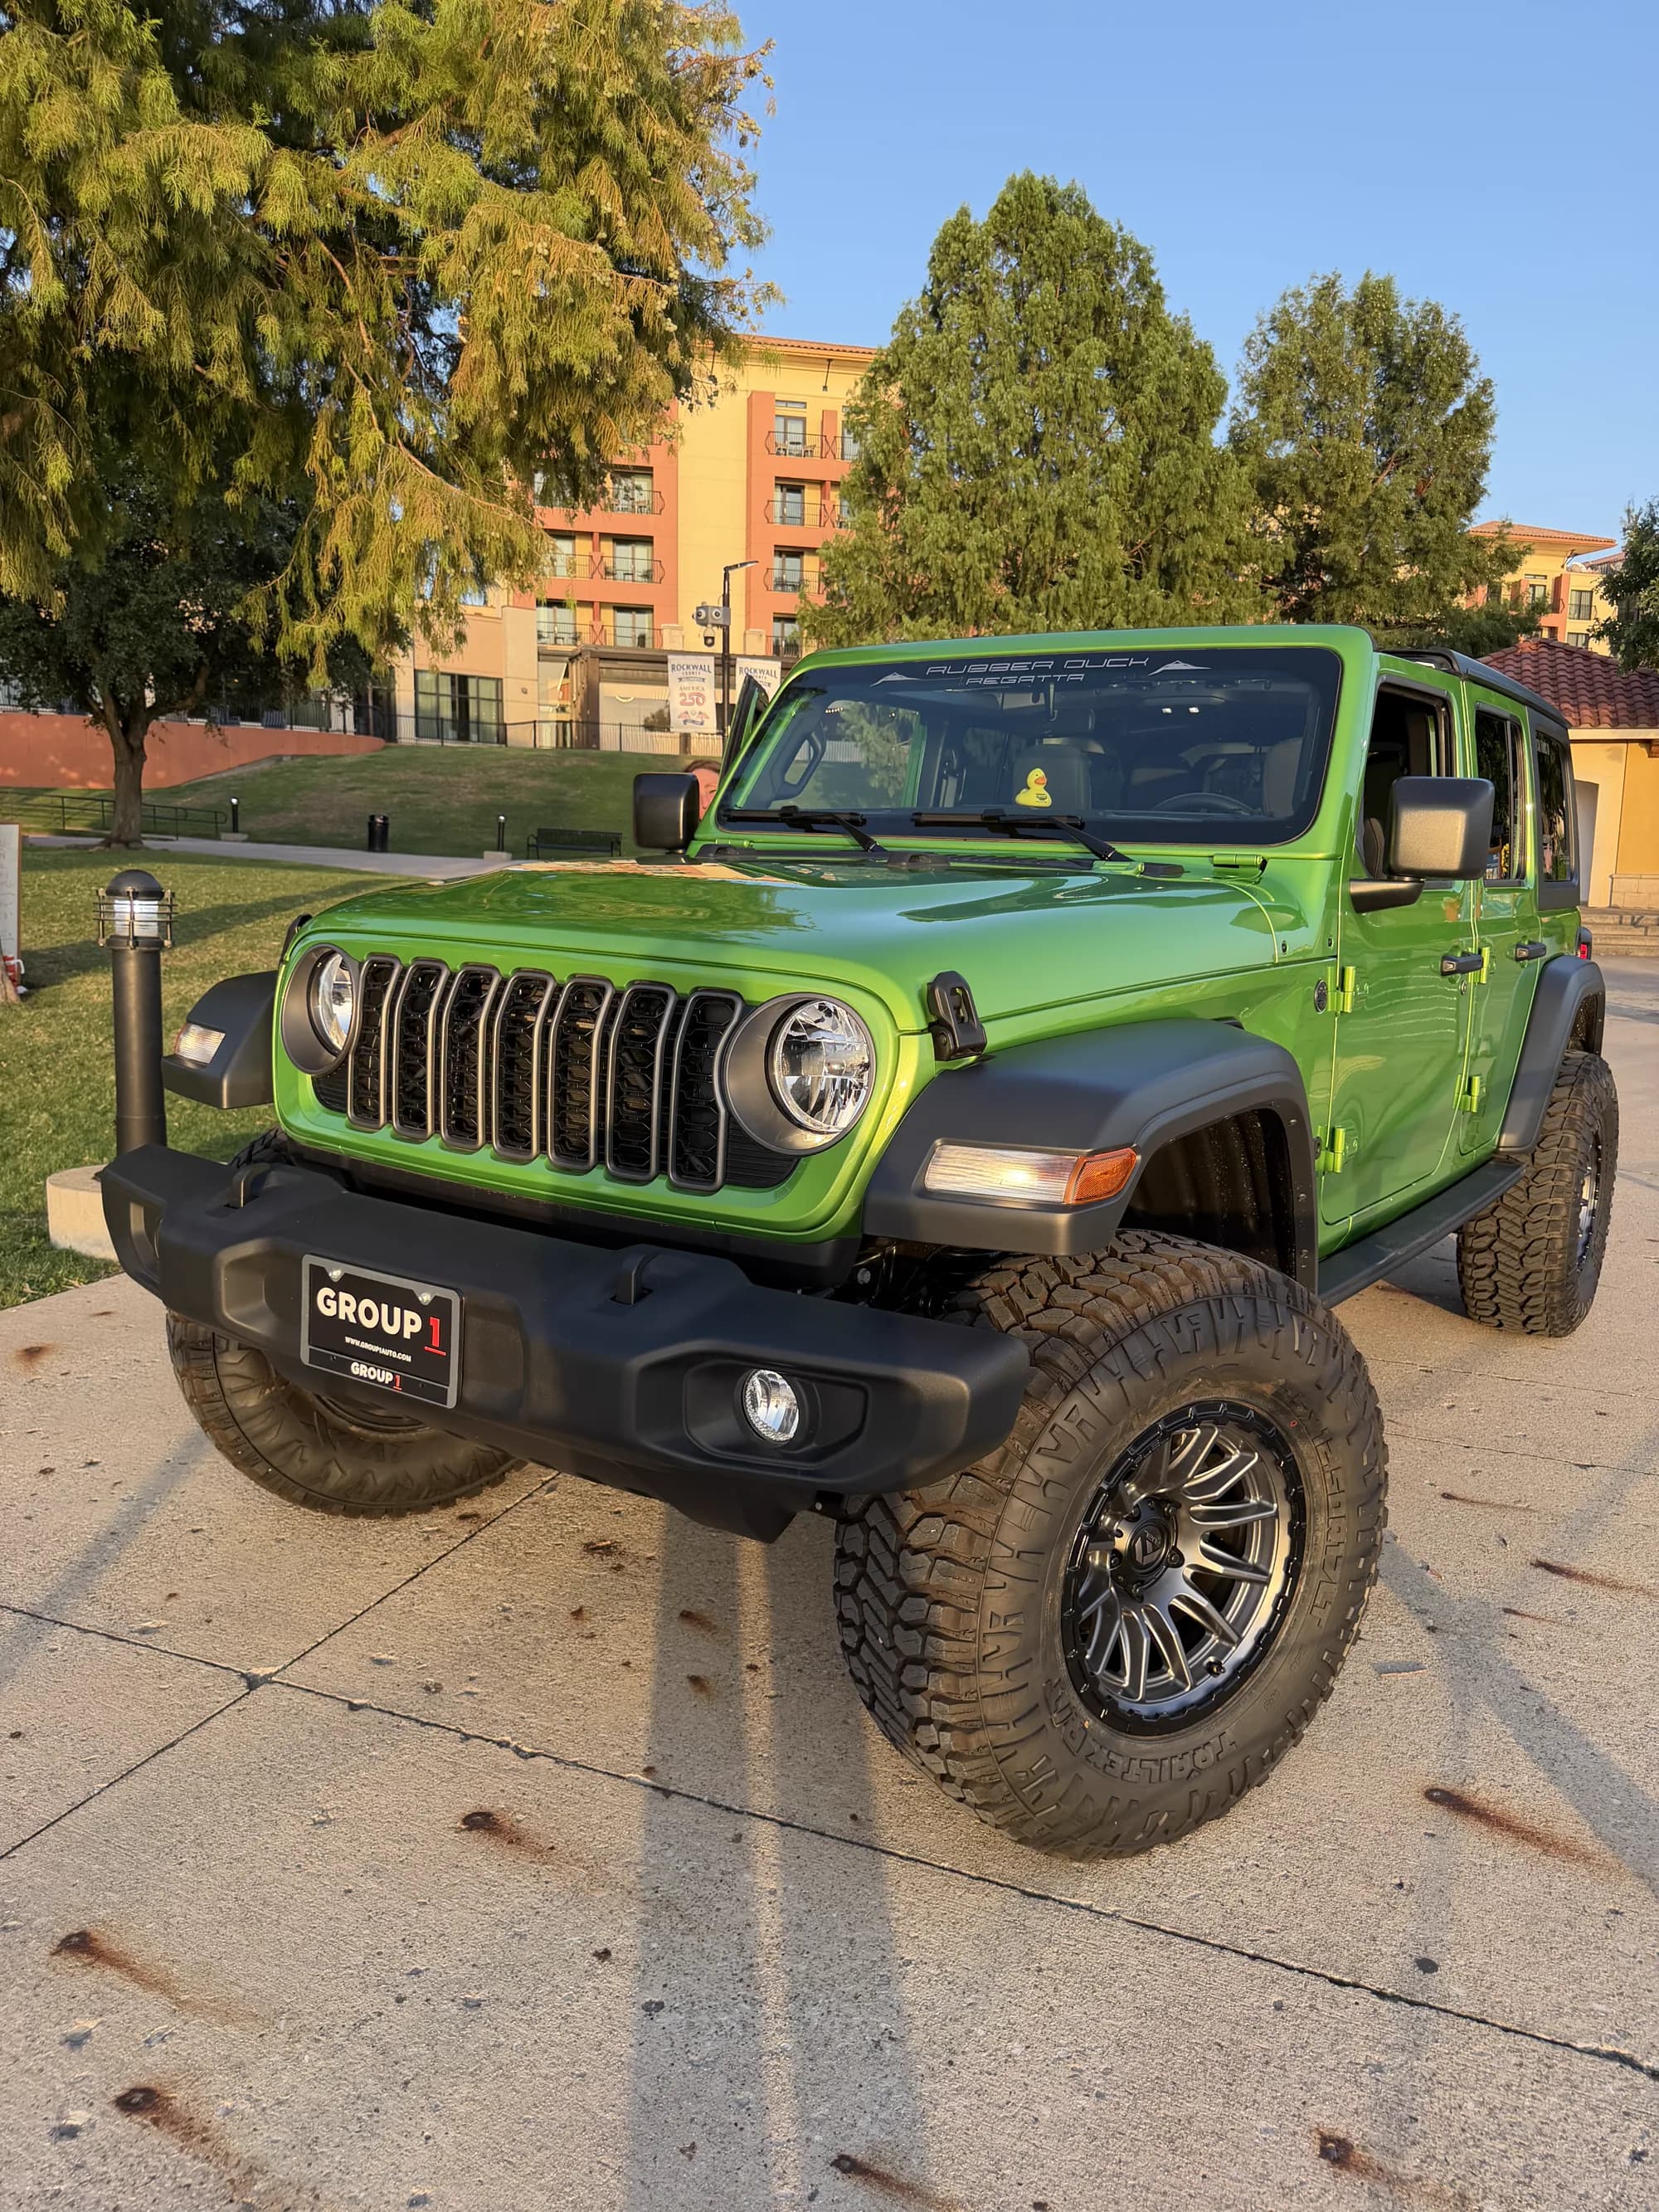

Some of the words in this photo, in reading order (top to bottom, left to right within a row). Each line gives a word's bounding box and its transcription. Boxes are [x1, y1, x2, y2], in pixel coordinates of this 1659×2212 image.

[671, 664, 712, 674] ROCKWALL
[739, 666, 777, 678] ROCKWALL
[926, 660, 1053, 675] RUBBER
[1063, 657, 1149, 669] DUCK
[966, 674, 1084, 685] REGATTA
[679, 692, 706, 707] 250
[316, 1287, 422, 1339] GROUP
[426, 1317, 445, 1353] 1
[350, 1362, 393, 1384] GROUP
